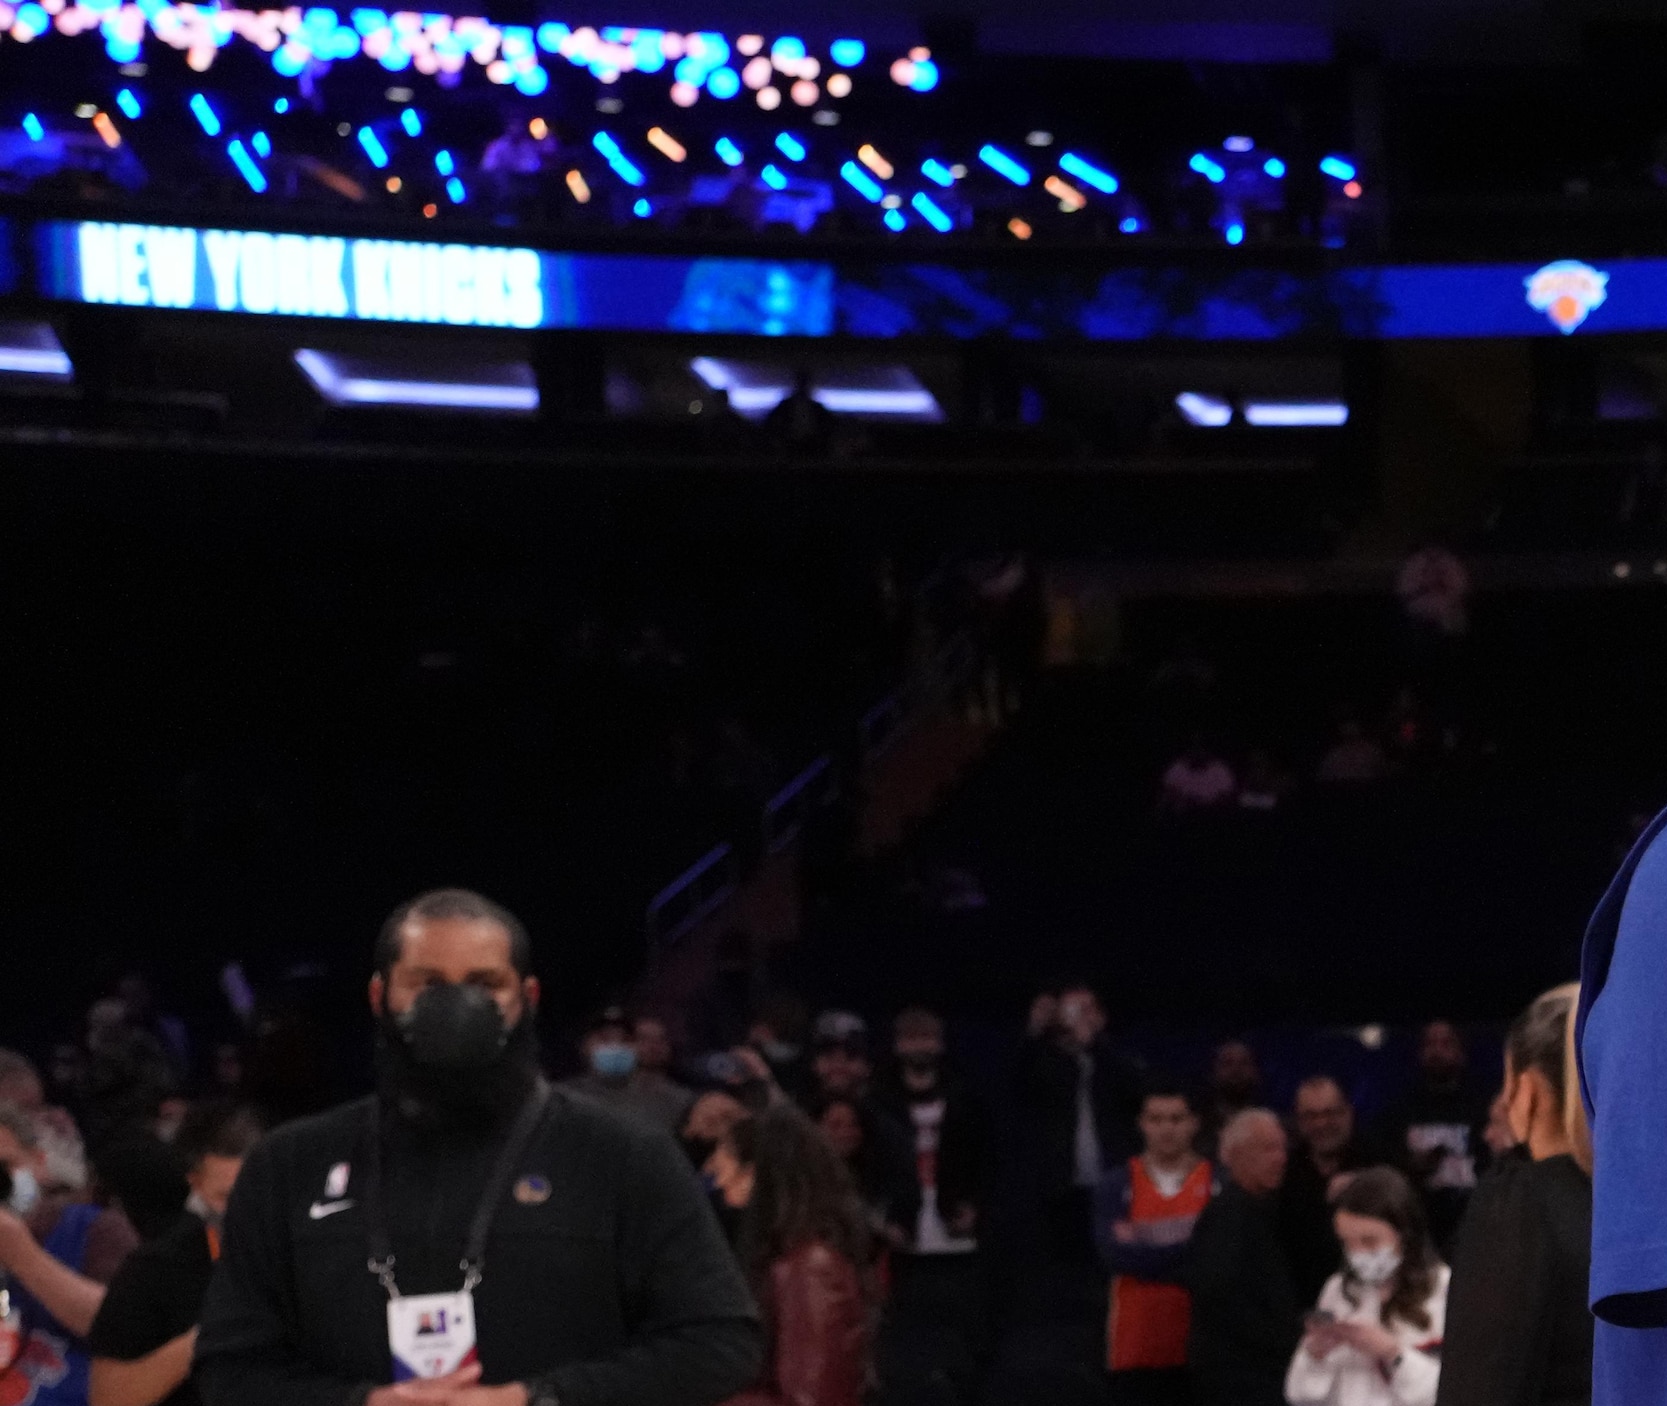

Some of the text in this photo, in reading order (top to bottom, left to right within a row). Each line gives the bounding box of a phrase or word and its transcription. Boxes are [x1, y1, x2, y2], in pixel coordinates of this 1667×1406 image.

[79, 221, 544, 329] NEW YORK KNICKS
